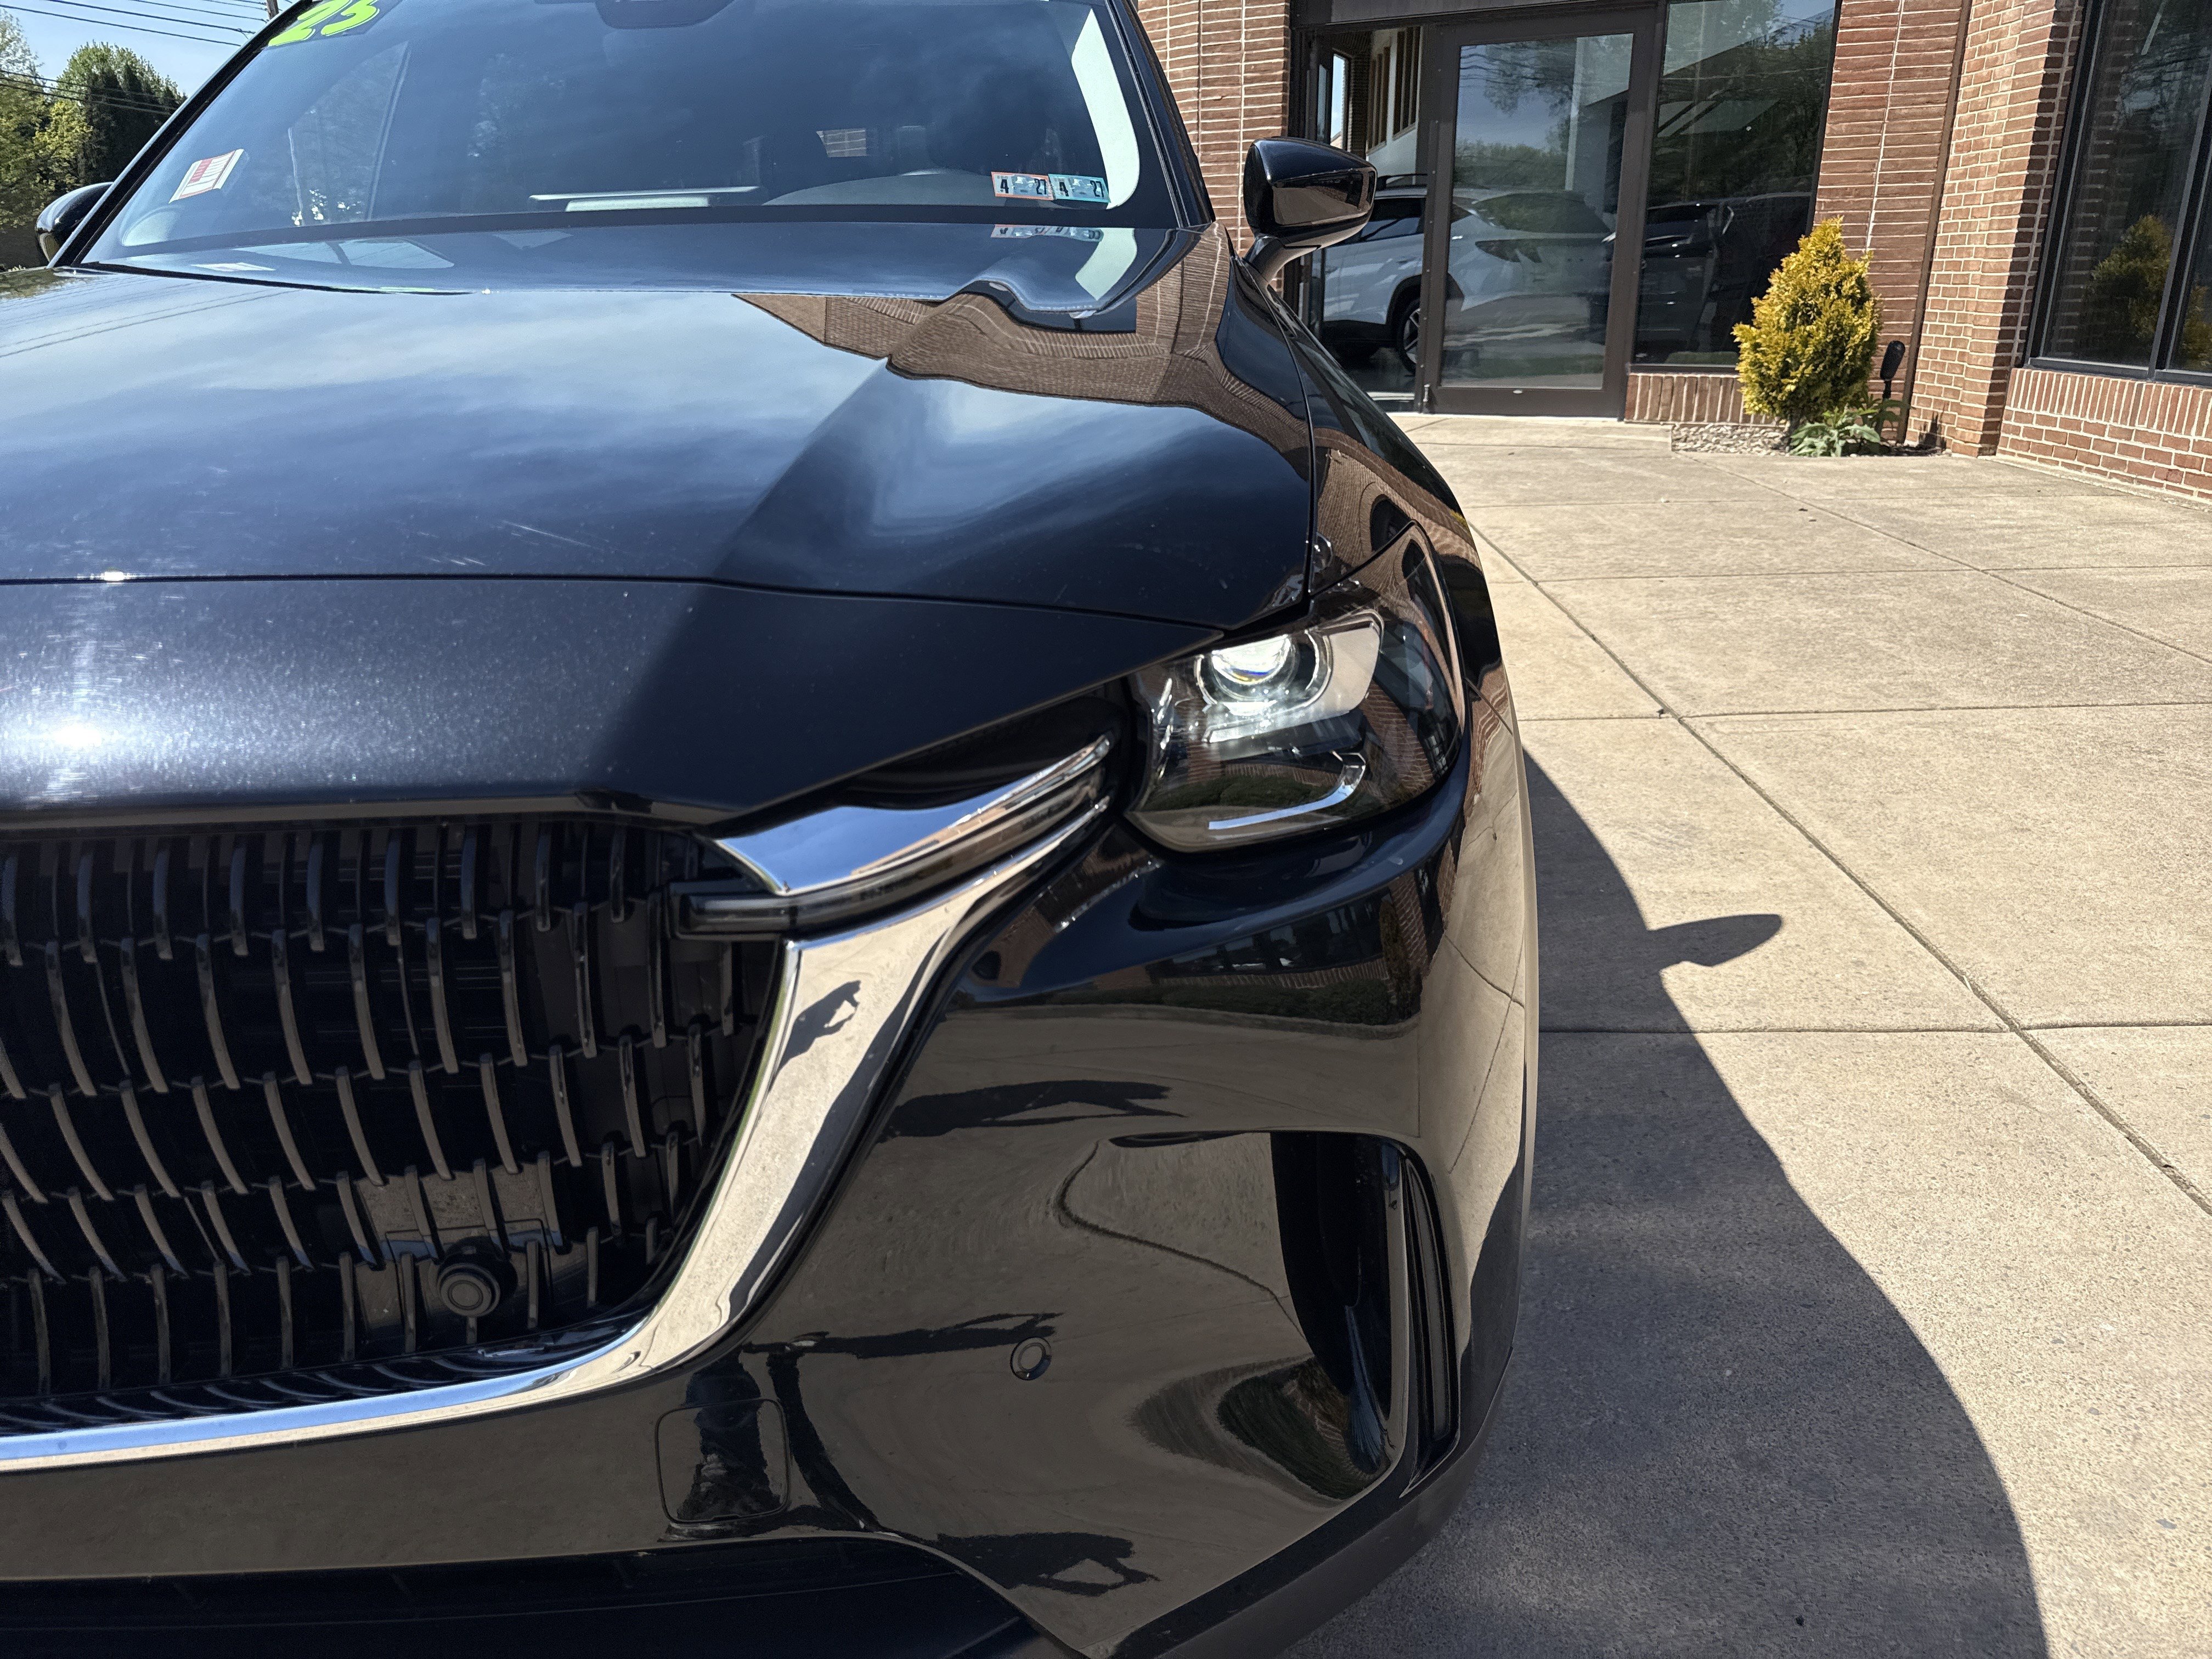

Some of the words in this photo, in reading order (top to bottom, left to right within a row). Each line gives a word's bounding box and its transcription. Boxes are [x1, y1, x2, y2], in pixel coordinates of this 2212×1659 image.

[1000, 179, 1009, 194] 4
[1034, 178, 1047, 195] 27
[1059, 182, 1069, 197] 4
[1090, 180, 1104, 198] 27
